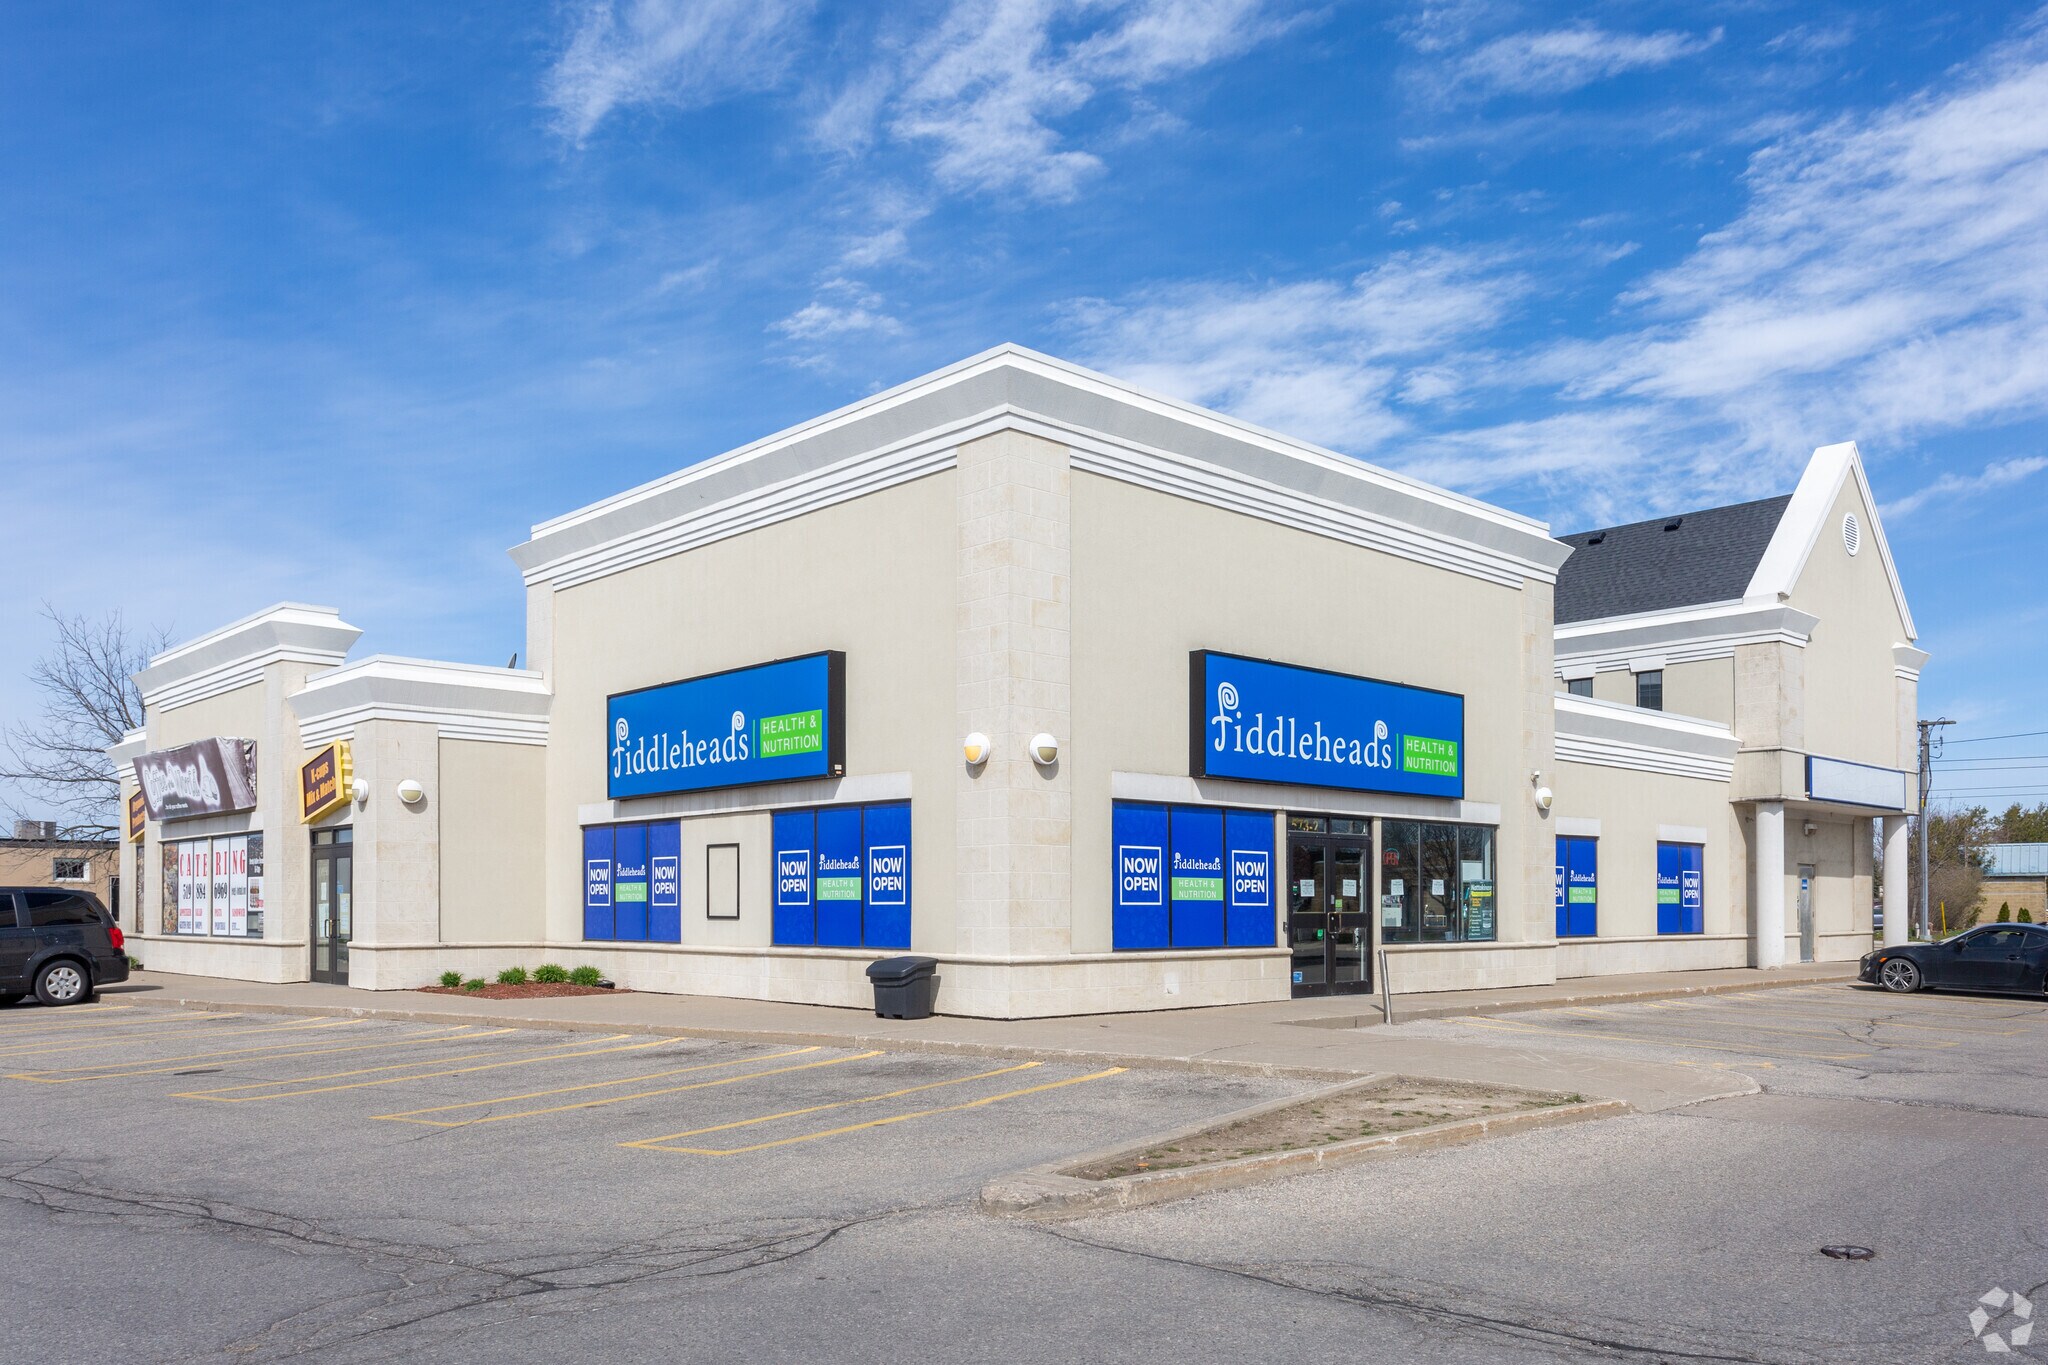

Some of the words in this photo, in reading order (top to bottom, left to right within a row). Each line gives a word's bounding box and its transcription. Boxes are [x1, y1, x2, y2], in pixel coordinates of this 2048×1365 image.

[763, 716, 806, 735] HEALTH
[809, 714, 817, 728] &
[763, 734, 819, 754] NUTRITION
[1406, 739, 1445, 755] HEALTH
[1448, 745, 1454, 756] &
[1406, 757, 1456, 773] NUTRITION
[179, 849, 246, 877] CATERING
[781, 861, 807, 876] NOW
[873, 857, 902, 874] NOW
[1124, 857, 1158, 874] NOW
[1235, 861, 1265, 877] NOW
[590, 868, 608, 881] NOW
[654, 866, 675, 880] NOW
[589, 883, 608, 895] OPEN
[654, 882, 675, 894] OPEN
[781, 878, 807, 892] OPEN
[822, 879, 848, 888] HEALTH
[872, 876, 902, 891] OPEN
[1123, 876, 1158, 891] OPEN
[1178, 879, 1208, 888] HEALTH
[1235, 879, 1265, 893] OPEN
[1684, 877, 1698, 888] NOW
[213, 882, 228, 899] 6969
[822, 890, 855, 898] NUTRITION
[1178, 890, 1217, 899] NUTRITION
[1684, 889, 1698, 899] OPEN
